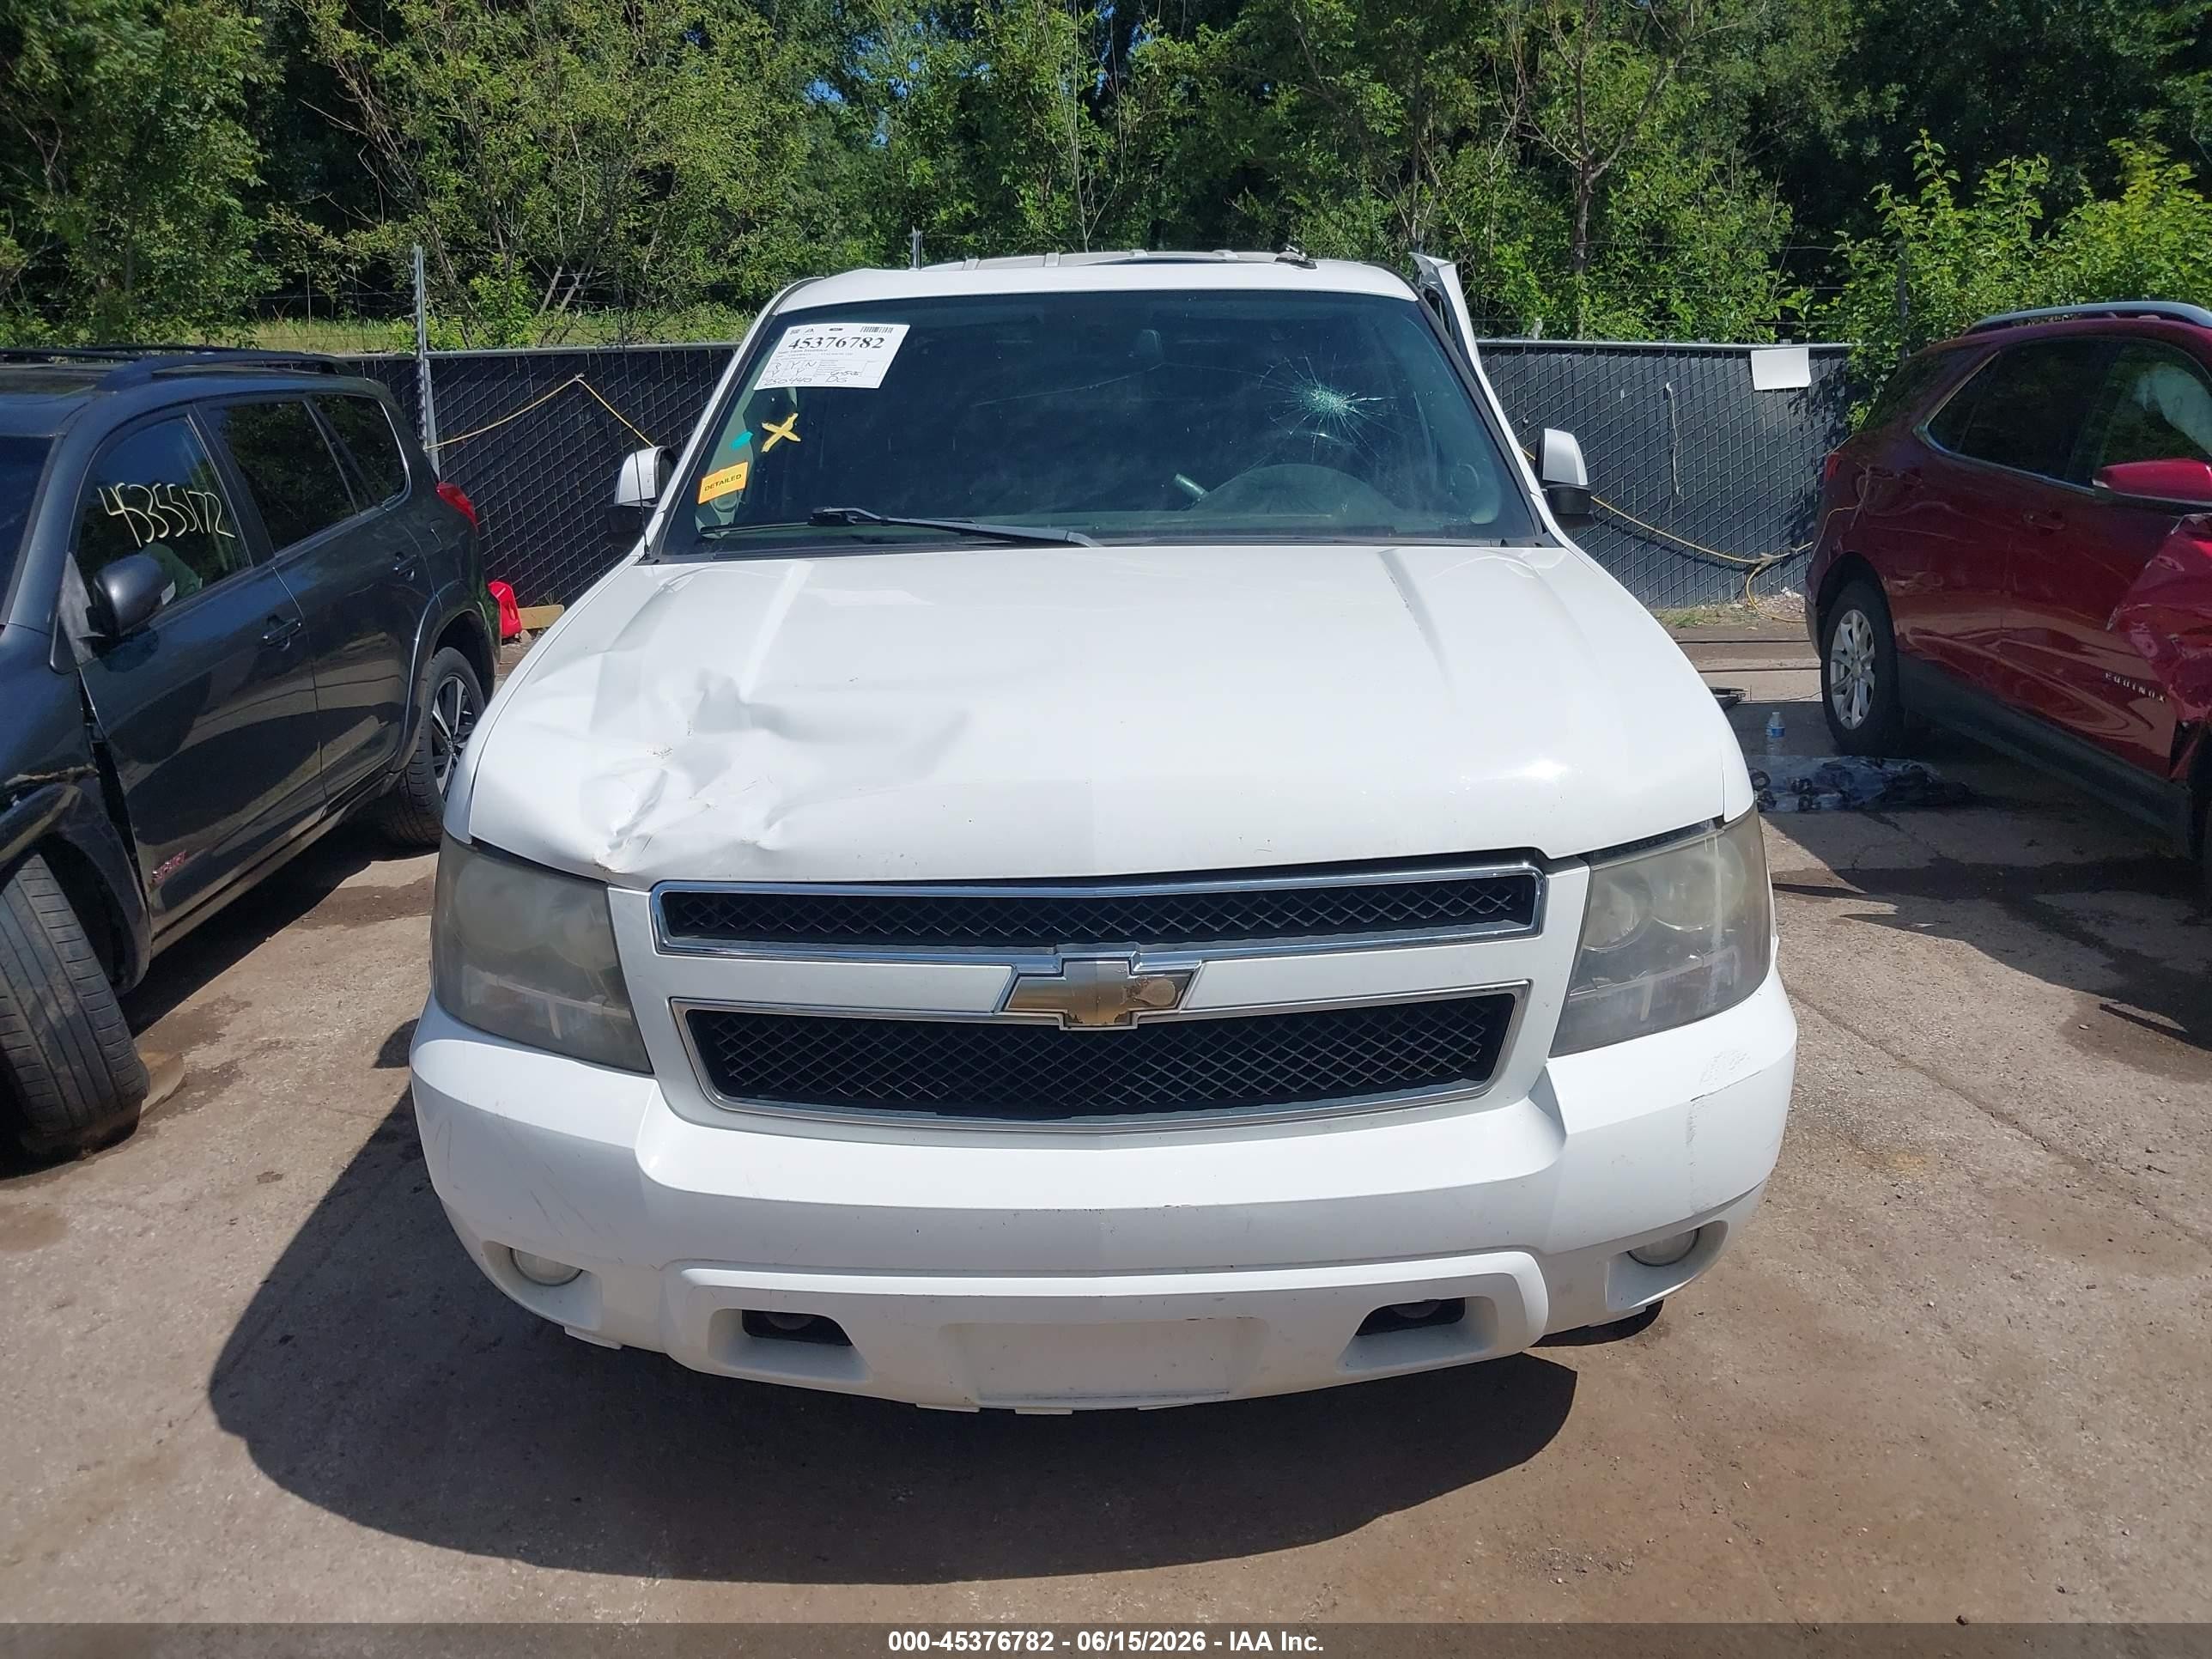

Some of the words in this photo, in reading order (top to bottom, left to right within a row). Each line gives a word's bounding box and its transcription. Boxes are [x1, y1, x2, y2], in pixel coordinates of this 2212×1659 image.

[787, 336, 885, 349] 45376782
[704, 473, 742, 491] DETAILED
[97, 483, 236, 548] 45355172
[2105, 672, 2165, 703] EQUINOX
